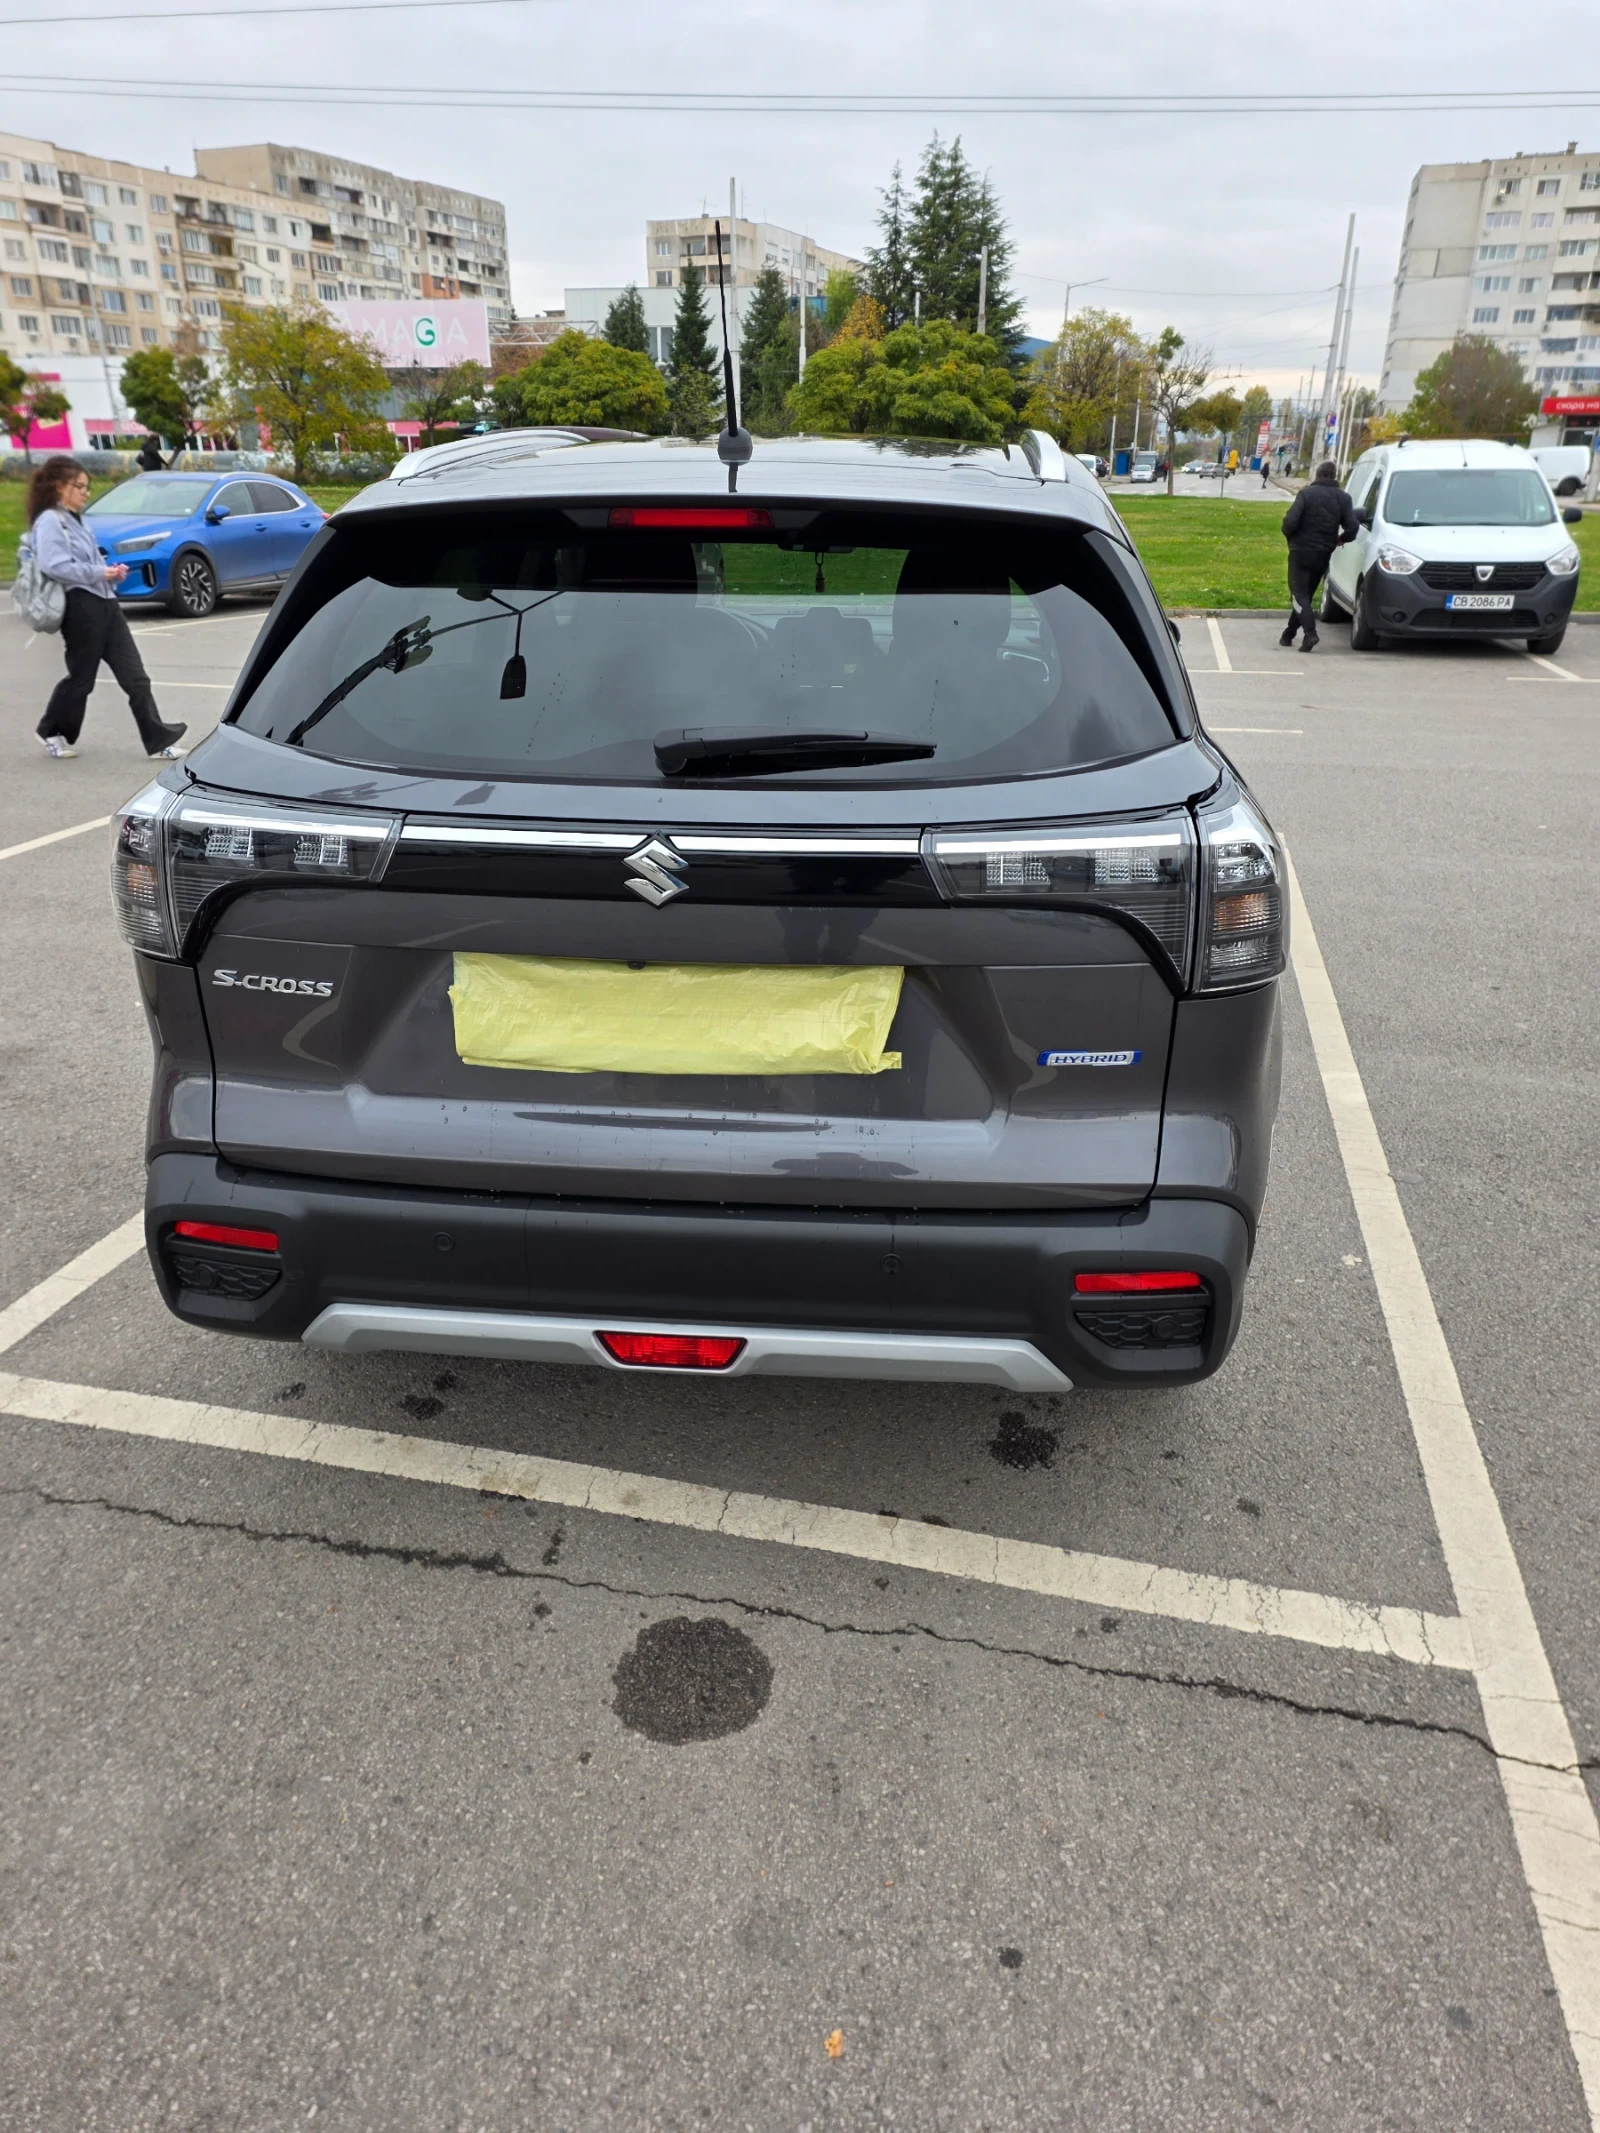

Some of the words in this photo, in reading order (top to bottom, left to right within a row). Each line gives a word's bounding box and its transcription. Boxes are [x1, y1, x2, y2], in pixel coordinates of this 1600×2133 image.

[1453, 596, 1468, 607] CB
[1470, 596, 1496, 607] 2086
[1497, 597, 1511, 607] PA
[212, 969, 334, 997] S-CROSS
[1054, 1054, 1127, 1064] HYBRID
